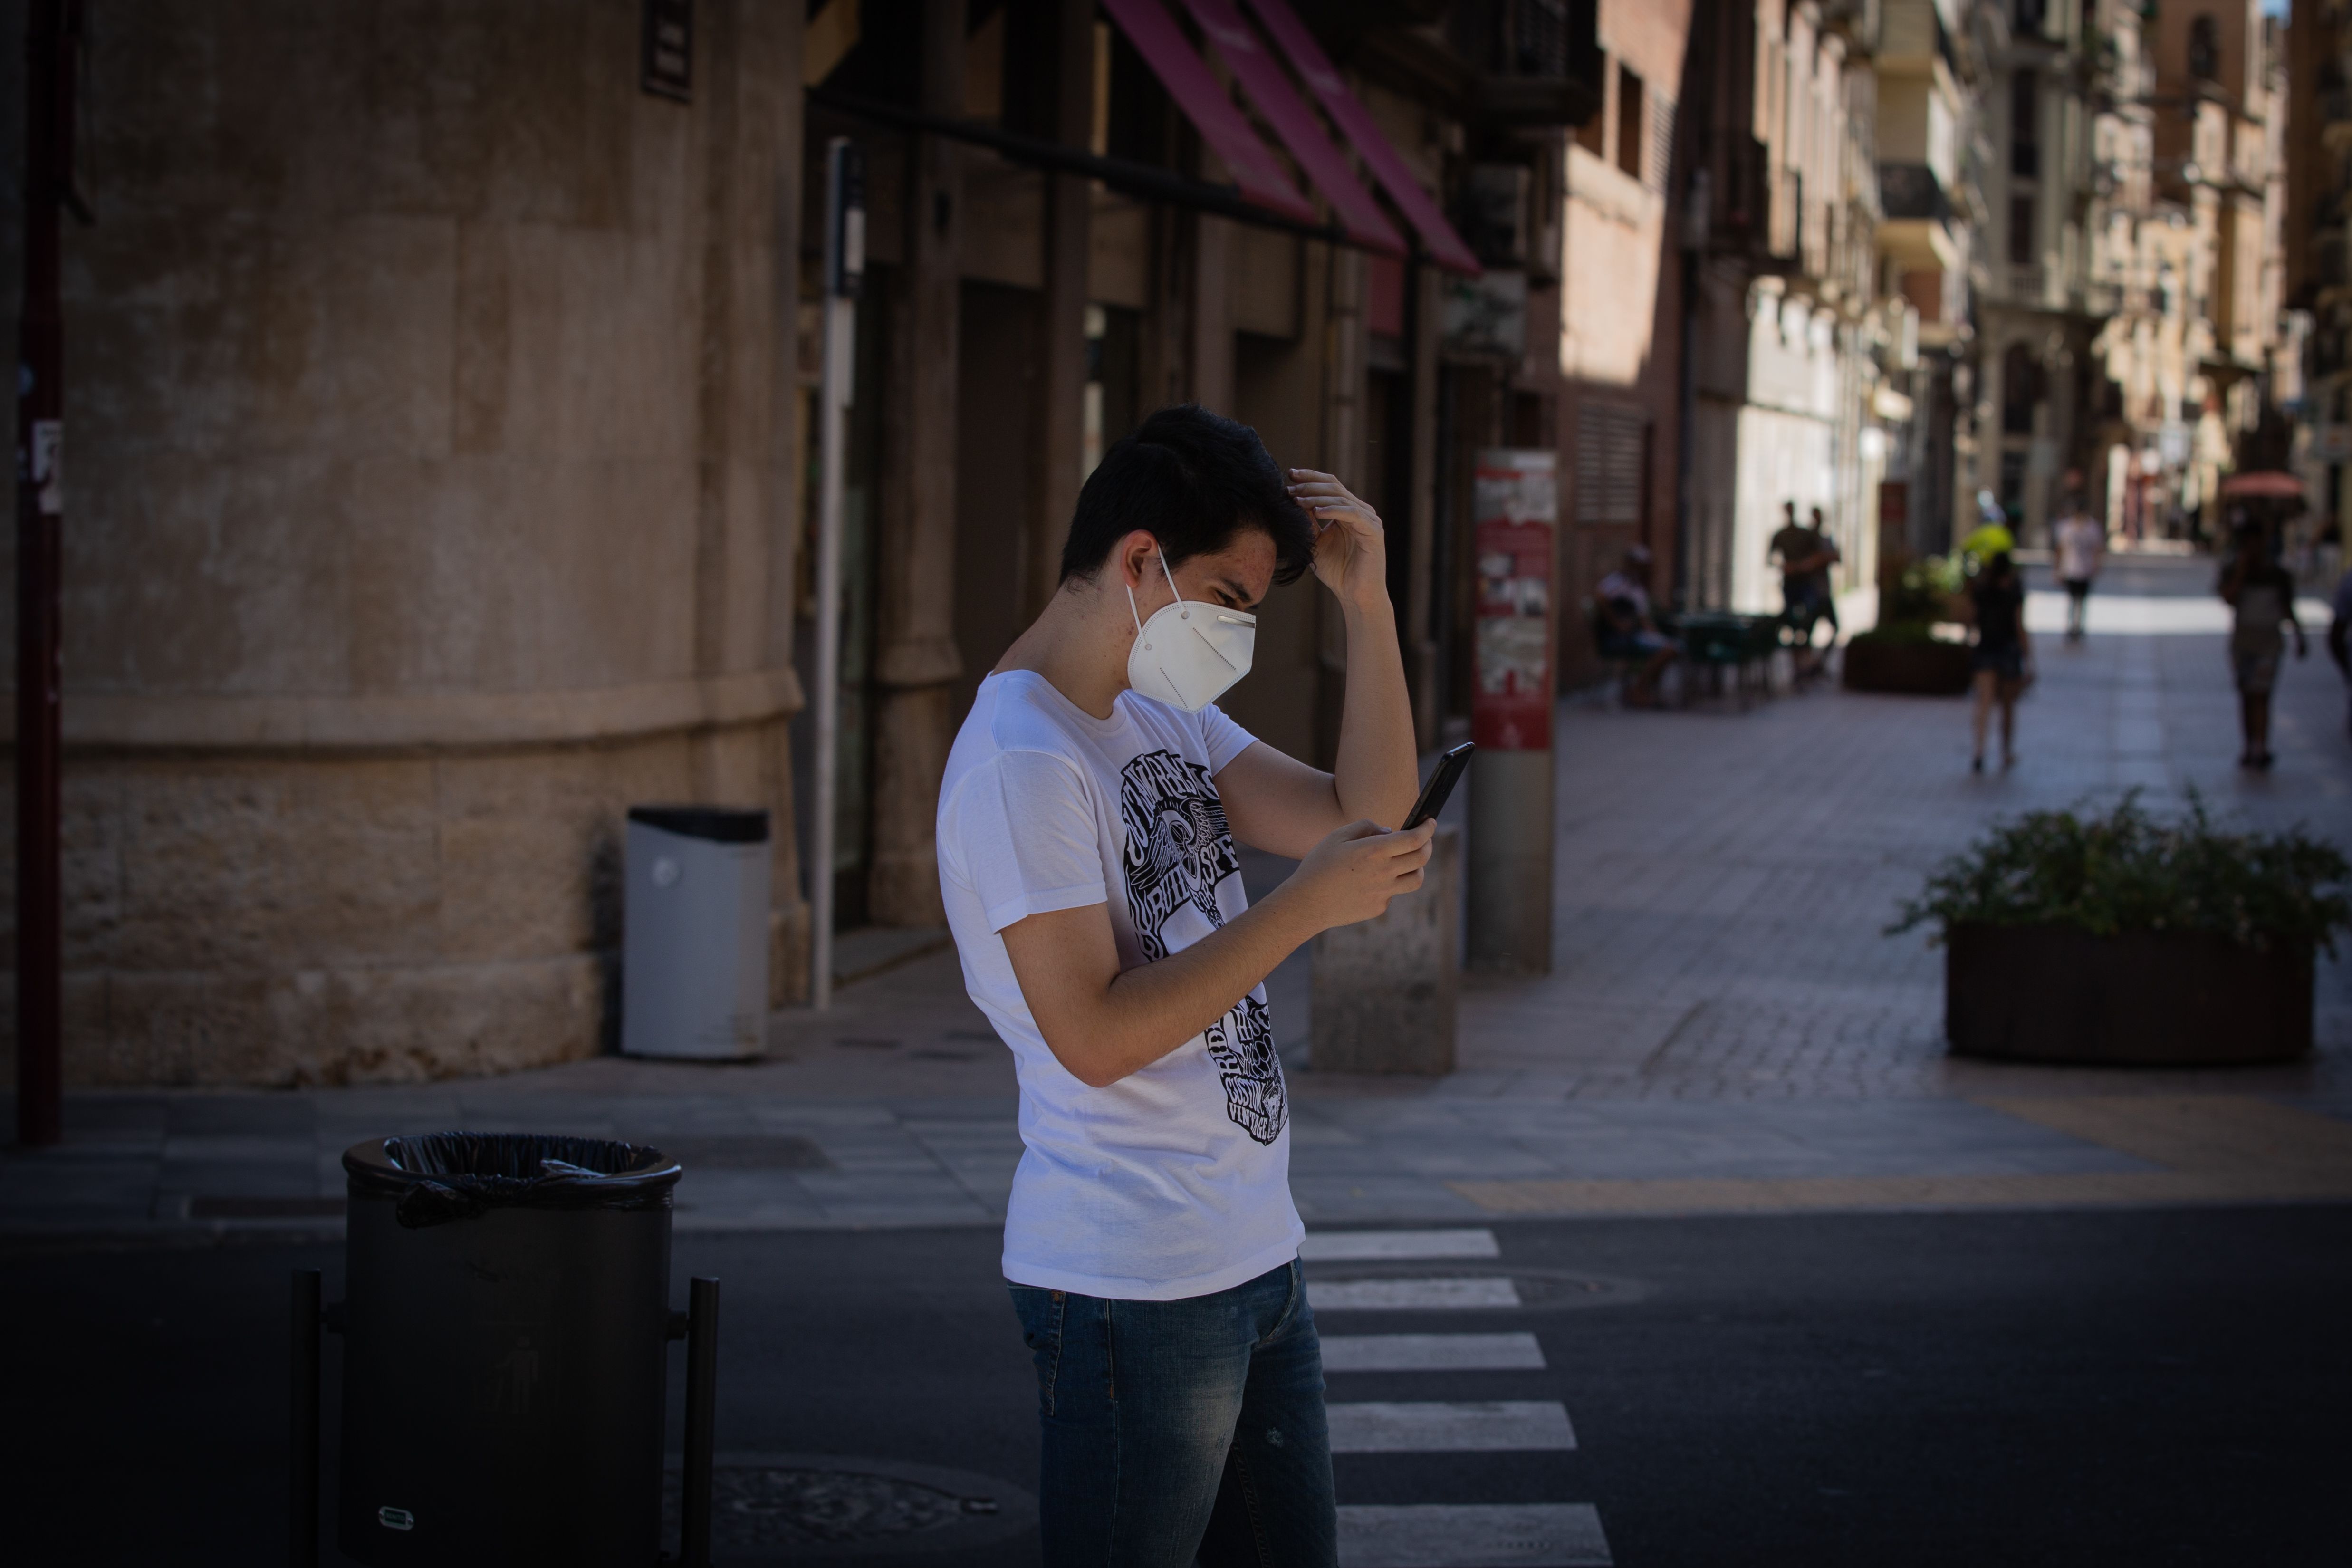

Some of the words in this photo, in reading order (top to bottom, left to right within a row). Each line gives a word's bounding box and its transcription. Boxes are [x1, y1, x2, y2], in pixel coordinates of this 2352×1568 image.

[1147, 865, 1190, 936] BUIL
[1200, 834, 1239, 885] SPE
[1225, 1075, 1266, 1115] CUSTOM
[1229, 1102, 1268, 1140] VINTAGE
